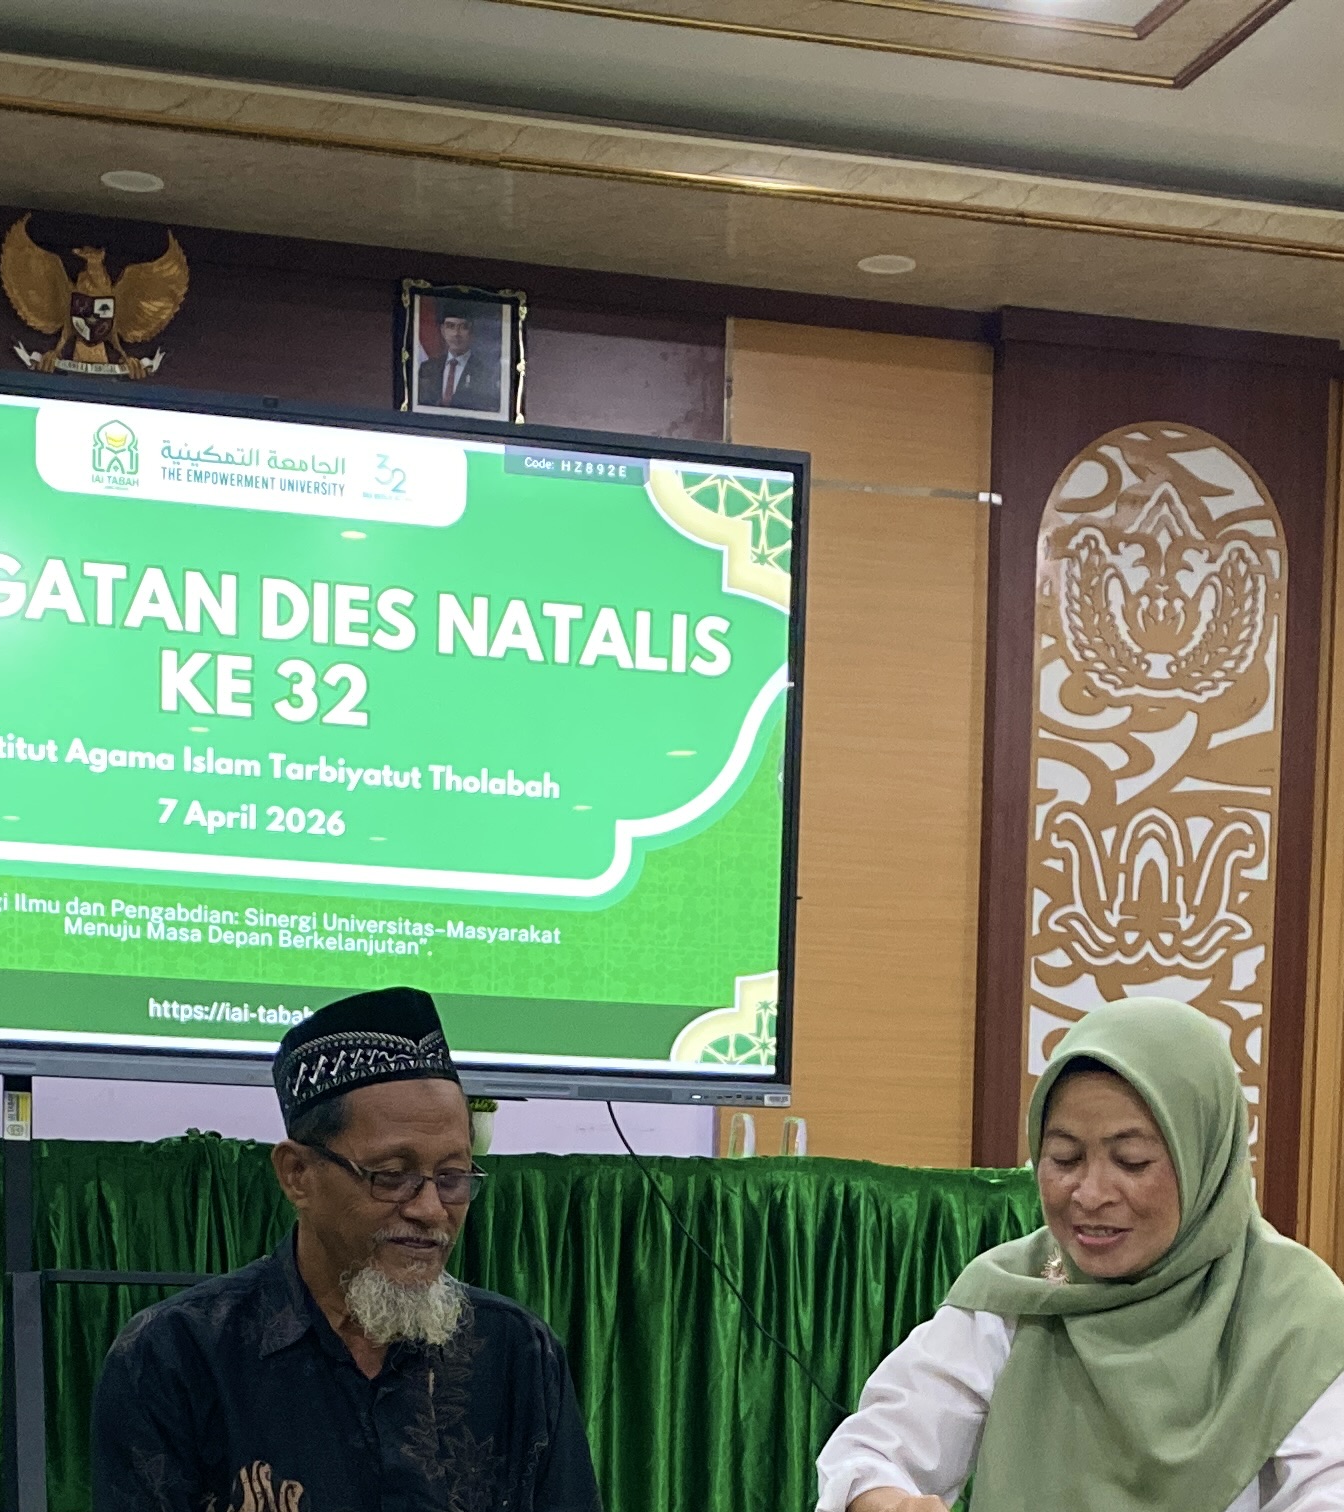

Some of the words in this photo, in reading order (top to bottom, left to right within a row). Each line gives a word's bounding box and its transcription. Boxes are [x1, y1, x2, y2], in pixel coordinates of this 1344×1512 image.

[107, 475, 139, 487] TABAH
[267, 449, 346, 479] الجامعة
[524, 457, 554, 470] Code:
[161, 466, 182, 481] THE
[187, 469, 275, 490] EMPOWERMENT
[280, 478, 345, 497] UNIVERSITY
[260, 576, 417, 652] DIES
[436, 591, 733, 677] NATALIS
[160, 647, 255, 718] KE
[273, 658, 370, 728] 32
[64, 737, 175, 773] Agama
[183, 745, 261, 777] Islam
[268, 752, 422, 791] Tarbiyatut
[428, 764, 560, 798] Tholabah
[158, 797, 179, 824] 7
[183, 800, 257, 834] April
[265, 805, 346, 836] 2026
[14, 892, 60, 914] Ilmu
[65, 896, 105, 917] dan
[111, 898, 239, 925] Pengabdian:
[244, 908, 317, 932] Sinergi
[64, 916, 141, 942] Menuju
[146, 922, 202, 943] Masa
[208, 926, 272, 948] Depan
